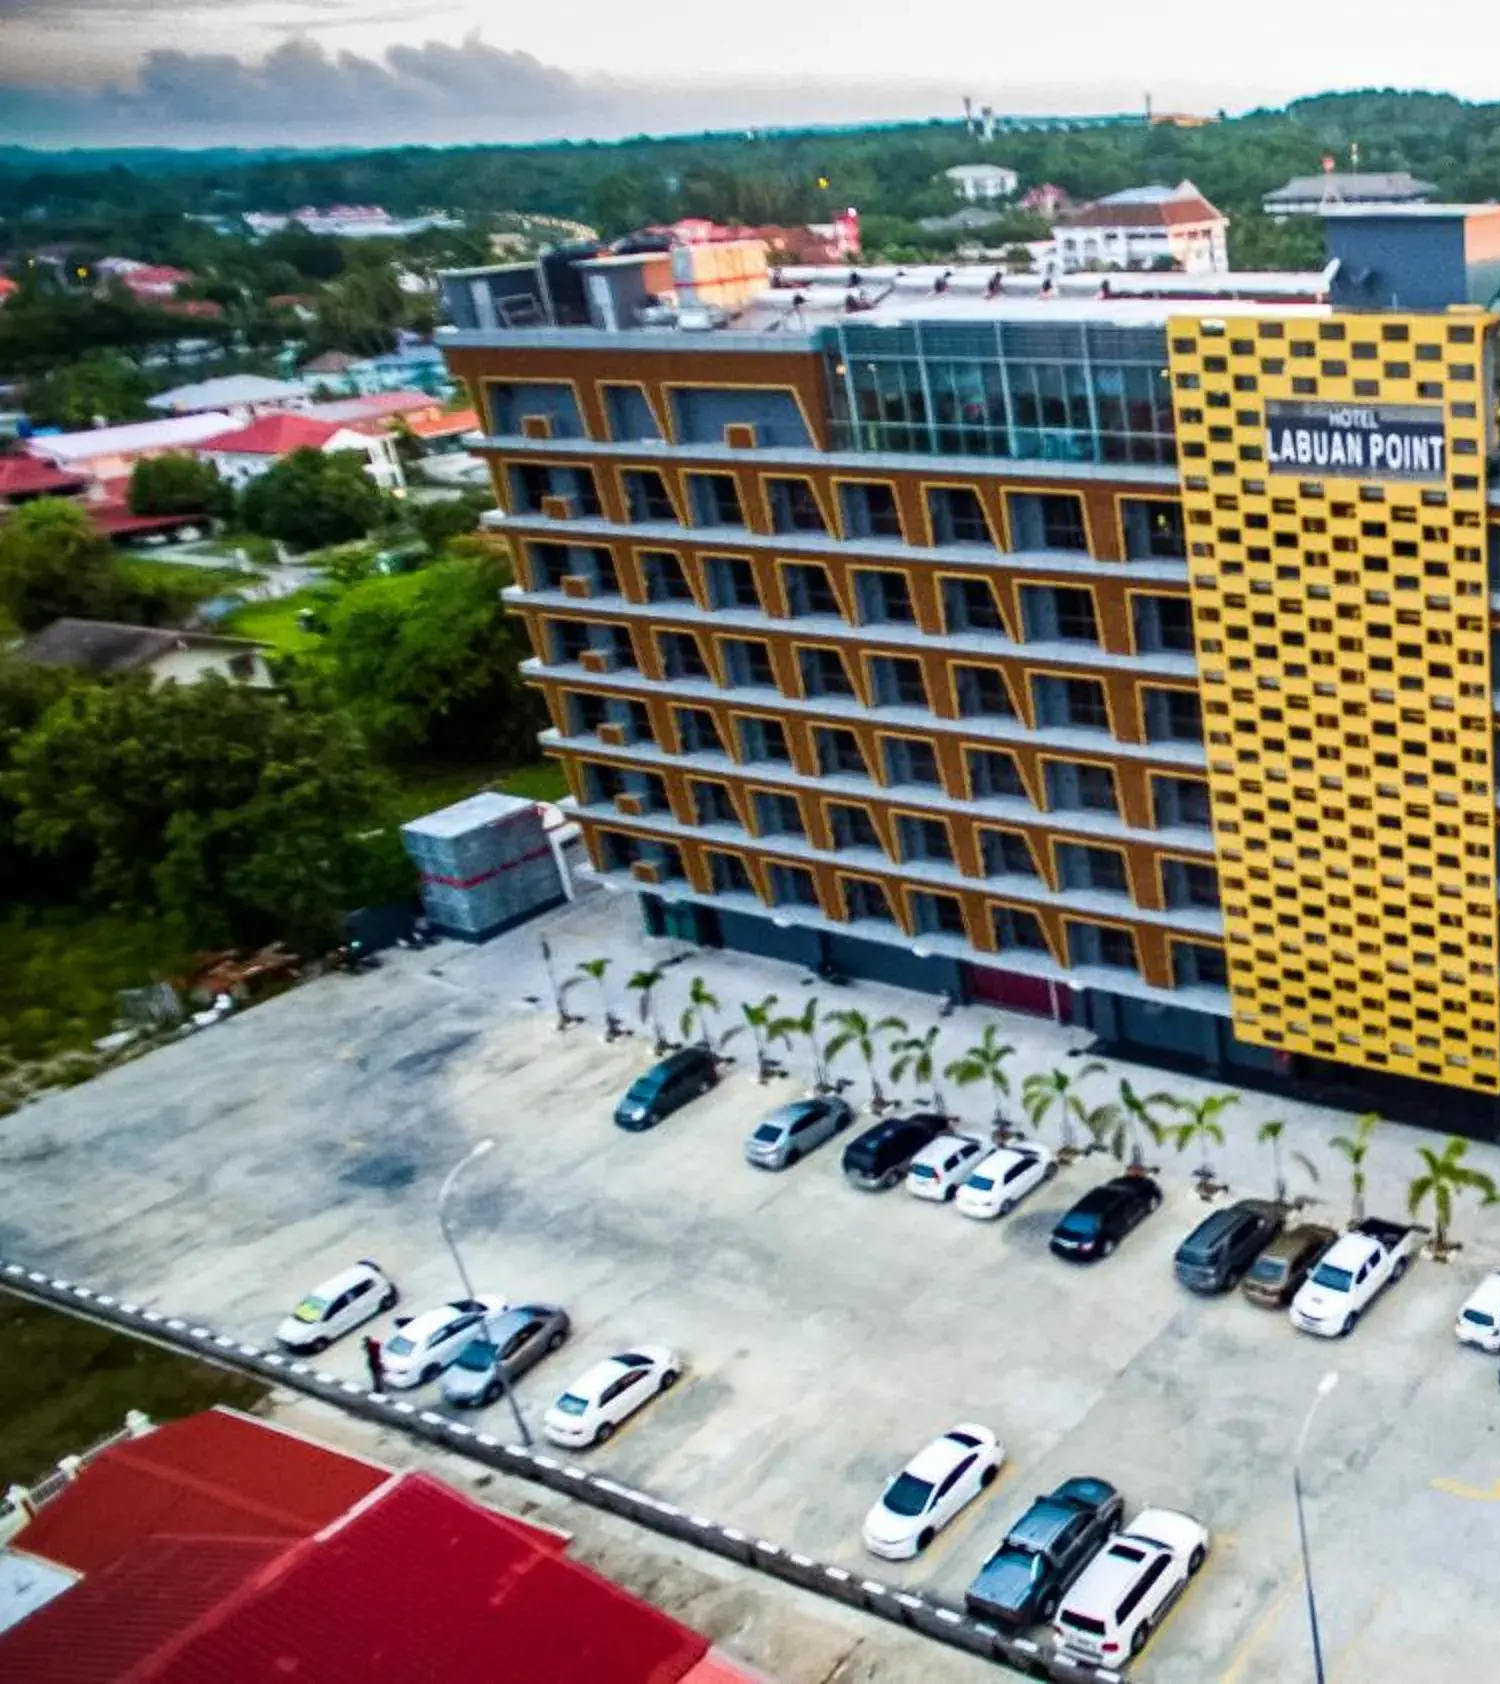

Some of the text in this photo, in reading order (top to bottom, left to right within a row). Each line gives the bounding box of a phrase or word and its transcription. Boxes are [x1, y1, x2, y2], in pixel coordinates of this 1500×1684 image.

[1328, 408, 1379, 429] HOTEL
[1266, 428, 1443, 471] LABUAN POINT
